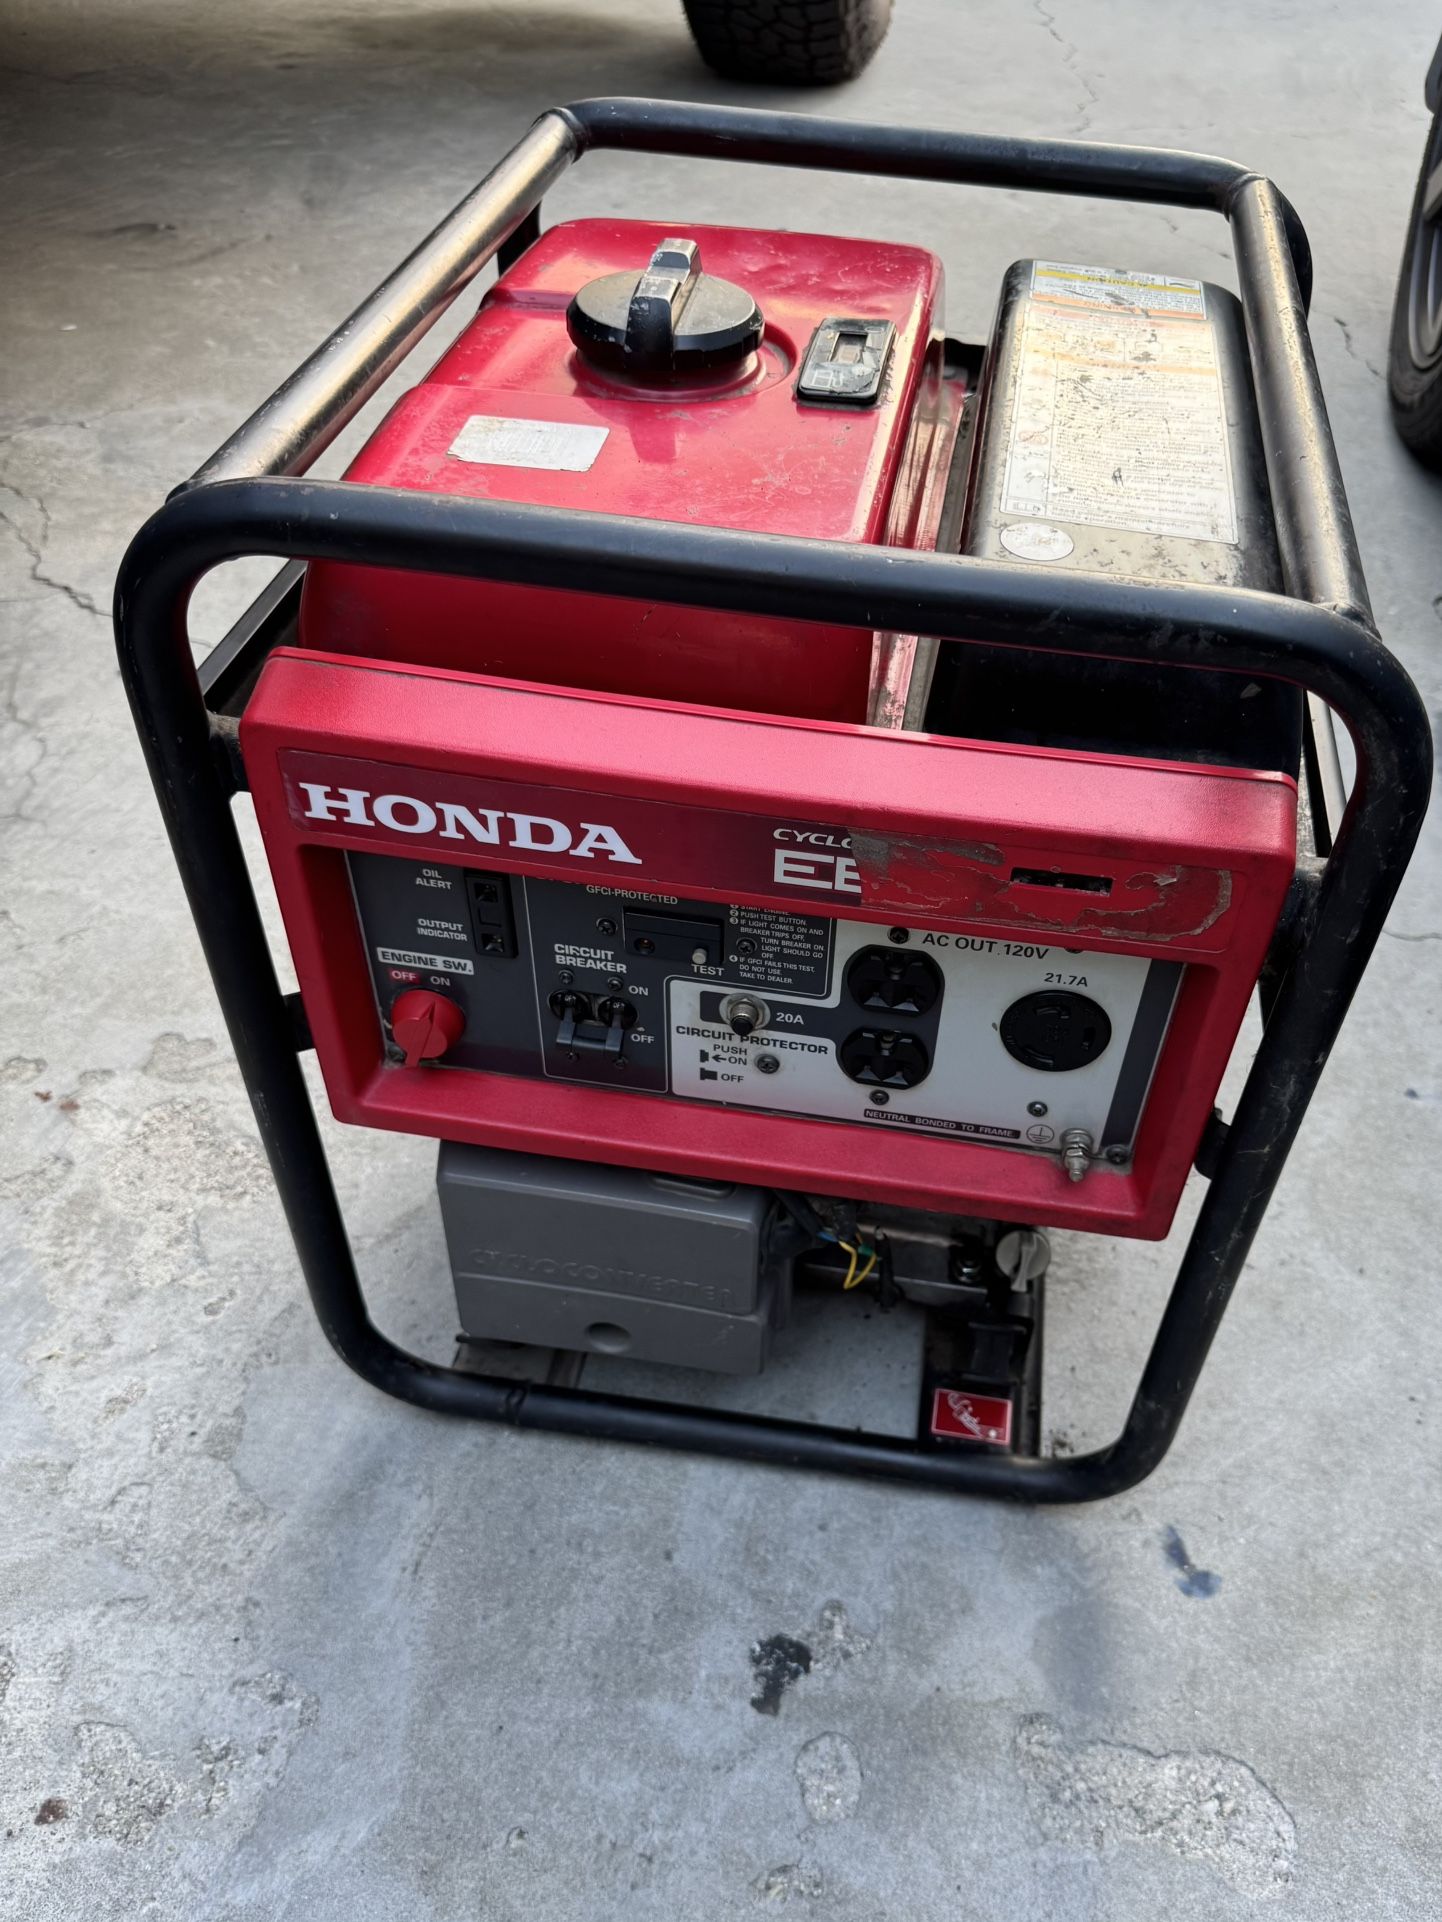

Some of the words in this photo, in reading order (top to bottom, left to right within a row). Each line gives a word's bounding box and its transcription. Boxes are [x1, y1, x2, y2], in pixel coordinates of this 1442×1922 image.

[299, 782, 643, 865] HONDA
[422, 868, 442, 879] OIL
[416, 878, 452, 889] ALERT
[586, 885, 678, 905] GFCI-PROTECTED
[740, 911, 759, 919] PUSH
[760, 914, 775, 922] TEST
[418, 919, 463, 931] OUTPUT
[748, 920, 768, 929] LIGHT
[770, 923, 794, 932] COMES
[796, 926, 808, 934] ON
[809, 928, 824, 936] AND
[417, 928, 468, 941] INDICATOR
[740, 926, 770, 936] BREAKER
[771, 931, 790, 939] TRIPS
[760, 937, 779, 946] TURN
[781, 940, 811, 950] BREAKER
[922, 933, 949, 947] AC
[1003, 943, 1049, 960] 120V
[554, 943, 614, 960] CIRCUIT
[761, 945, 781, 953] LIGHT
[783, 948, 810, 957] SHOULD
[812, 951, 823, 959] GO
[381, 951, 438, 967] ENGINE
[442, 960, 472, 973] SW.
[555, 955, 627, 974] BREAKER
[747, 957, 763, 965] GFCI
[764, 960, 782, 968] FAILS
[783, 962, 798, 970] THIS
[392, 970, 417, 981] OFF
[691, 963, 725, 976] TEST
[739, 964, 750, 972] DO
[751, 966, 766, 974] NOT
[430, 976, 451, 986] ON
[739, 971, 756, 979] TAKE
[756, 973, 766, 981] TO
[1044, 972, 1088, 987] 21.7A
[629, 985, 649, 996] ON
[776, 1012, 804, 1025] 20A
[631, 1034, 655, 1044] OFF
[676, 1025, 735, 1042] CIRCUIT
[740, 1035, 828, 1055] PROTECTOR
[713, 1044, 748, 1056] PUSH
[728, 1056, 748, 1066] ON
[721, 1073, 745, 1084] OFF
[865, 1110, 911, 1123] NEUTRAL
[915, 1117, 956, 1129] BONDED
[961, 1124, 975, 1132] TO
